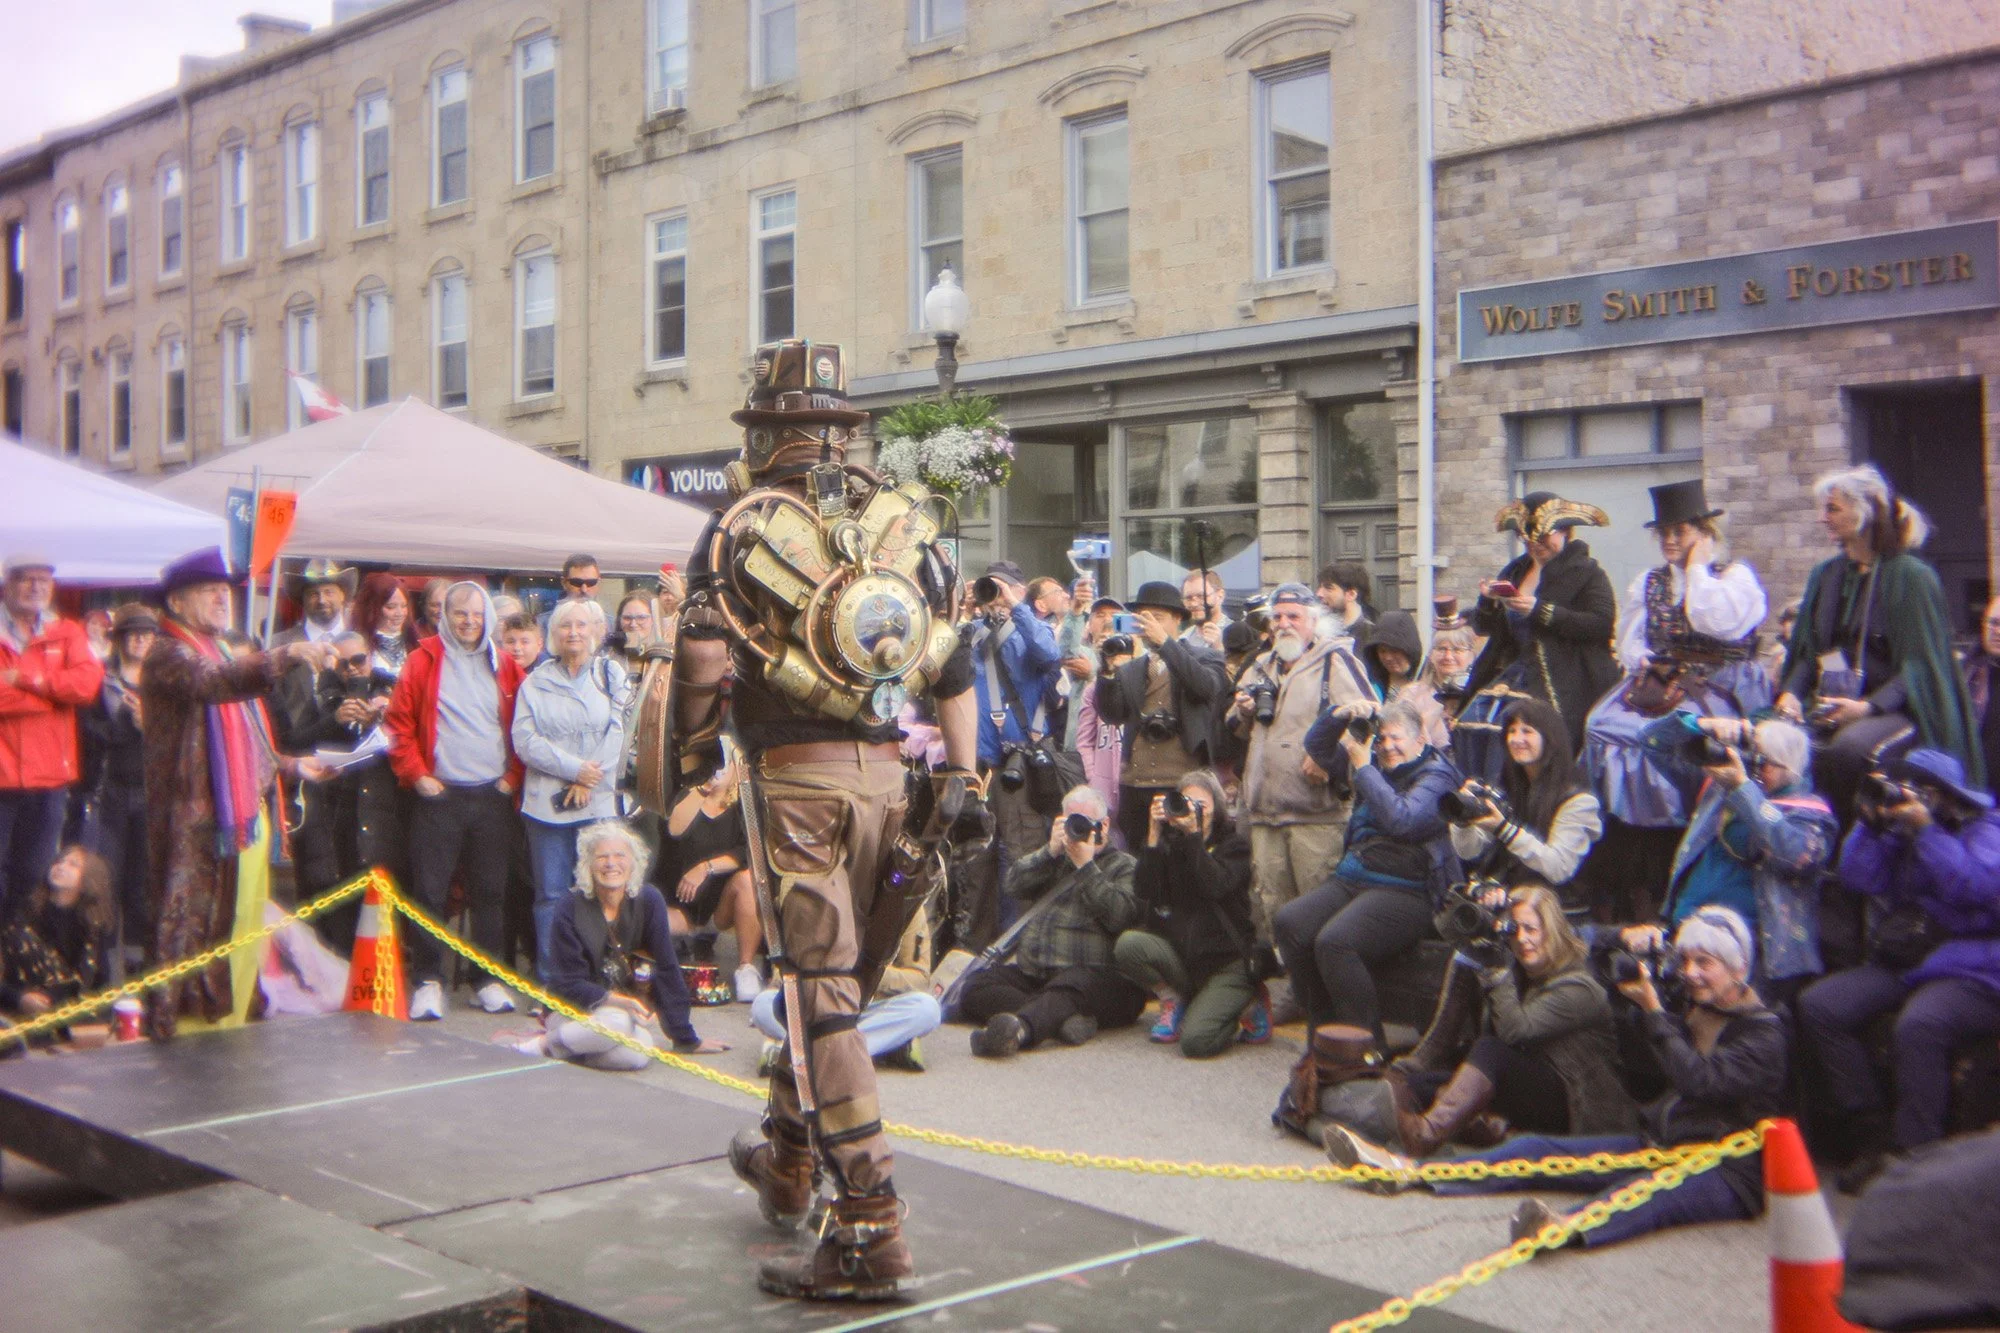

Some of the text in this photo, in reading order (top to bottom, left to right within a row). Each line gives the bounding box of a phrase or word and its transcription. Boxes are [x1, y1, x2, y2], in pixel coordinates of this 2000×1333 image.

[1479, 251, 1974, 336] WOLFE SMITH & FORSTER
[670, 468, 728, 493] YOUTO
